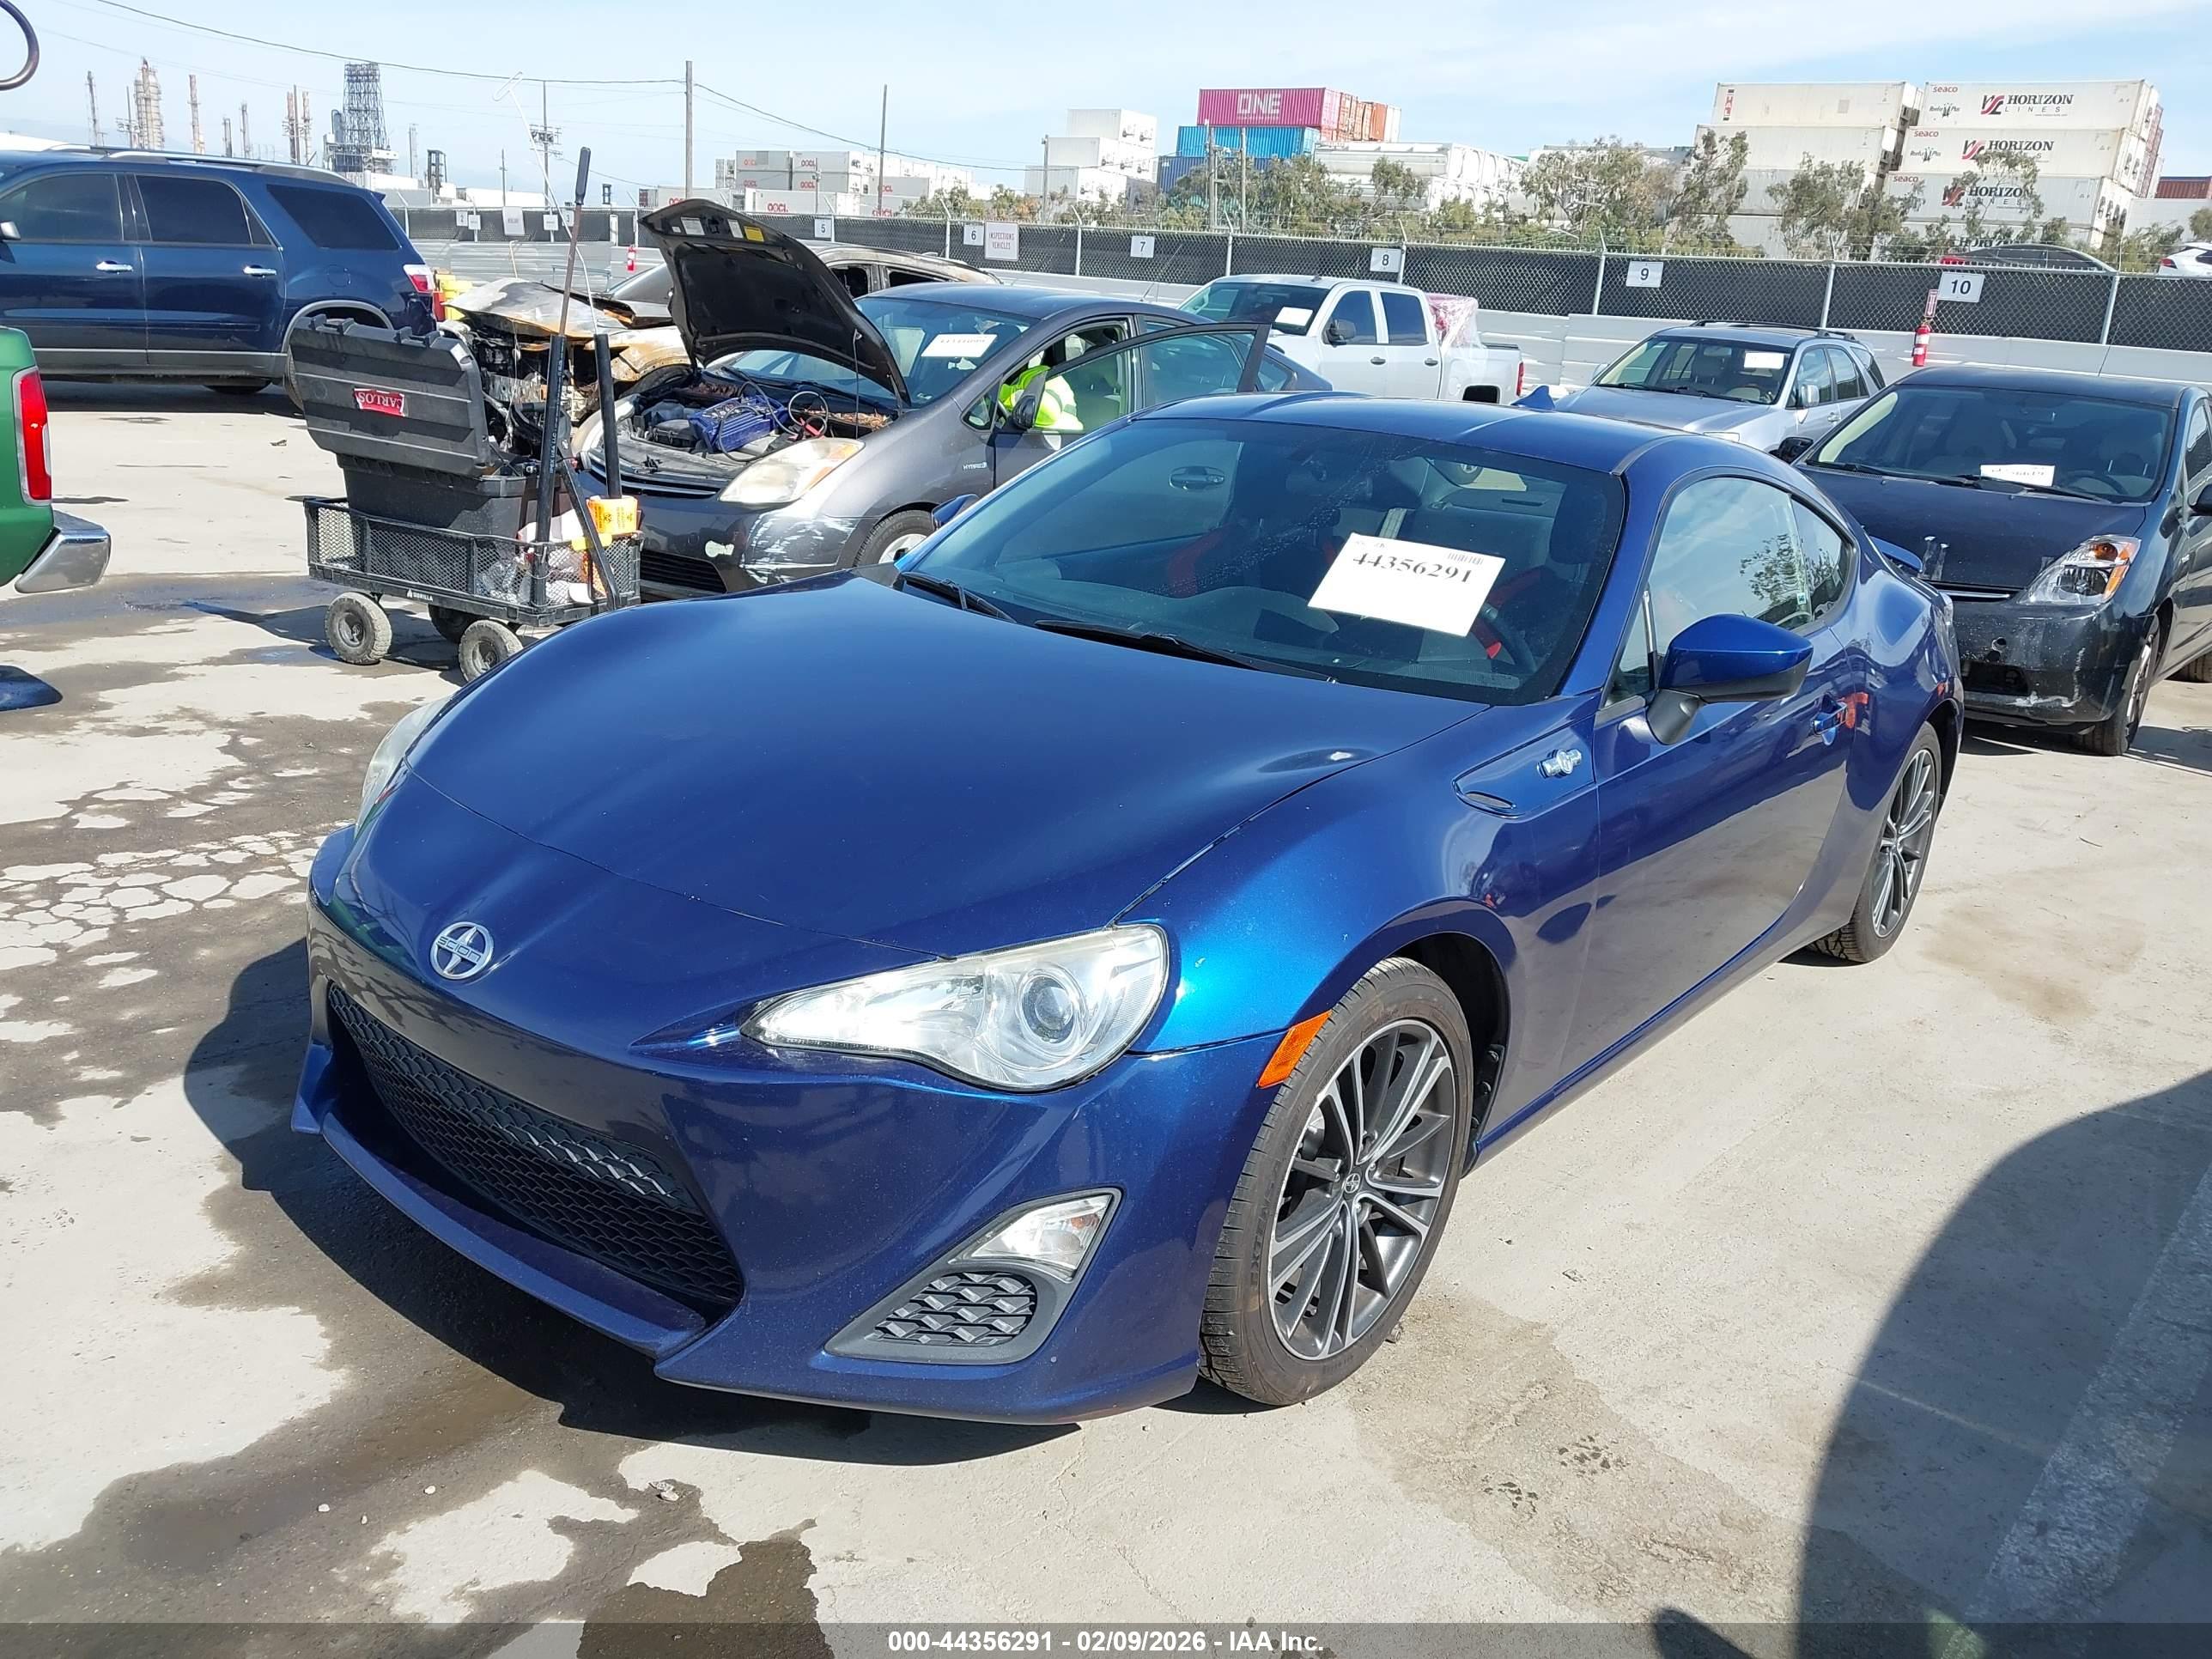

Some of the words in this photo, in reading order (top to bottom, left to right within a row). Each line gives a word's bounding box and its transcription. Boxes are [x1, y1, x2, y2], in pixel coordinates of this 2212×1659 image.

[1237, 93, 1281, 114] ONE
[2006, 94, 2075, 105] HORIZON
[1987, 140, 2055, 151] HORIZON
[767, 203, 789, 213] OOCL
[821, 224, 826, 234] 5
[971, 230, 977, 240] 6
[992, 240, 1011, 251] VEHICLES
[1140, 241, 1146, 252] 7
[1382, 254, 1389, 266] 8
[1640, 268, 1650, 281] 9
[1951, 279, 1972, 295] 10
[358, 392, 403, 409] CARLOS
[1352, 552, 1472, 583] 44356291
[412, 592, 434, 602] GORILLA
[436, 936, 482, 963] SCION
